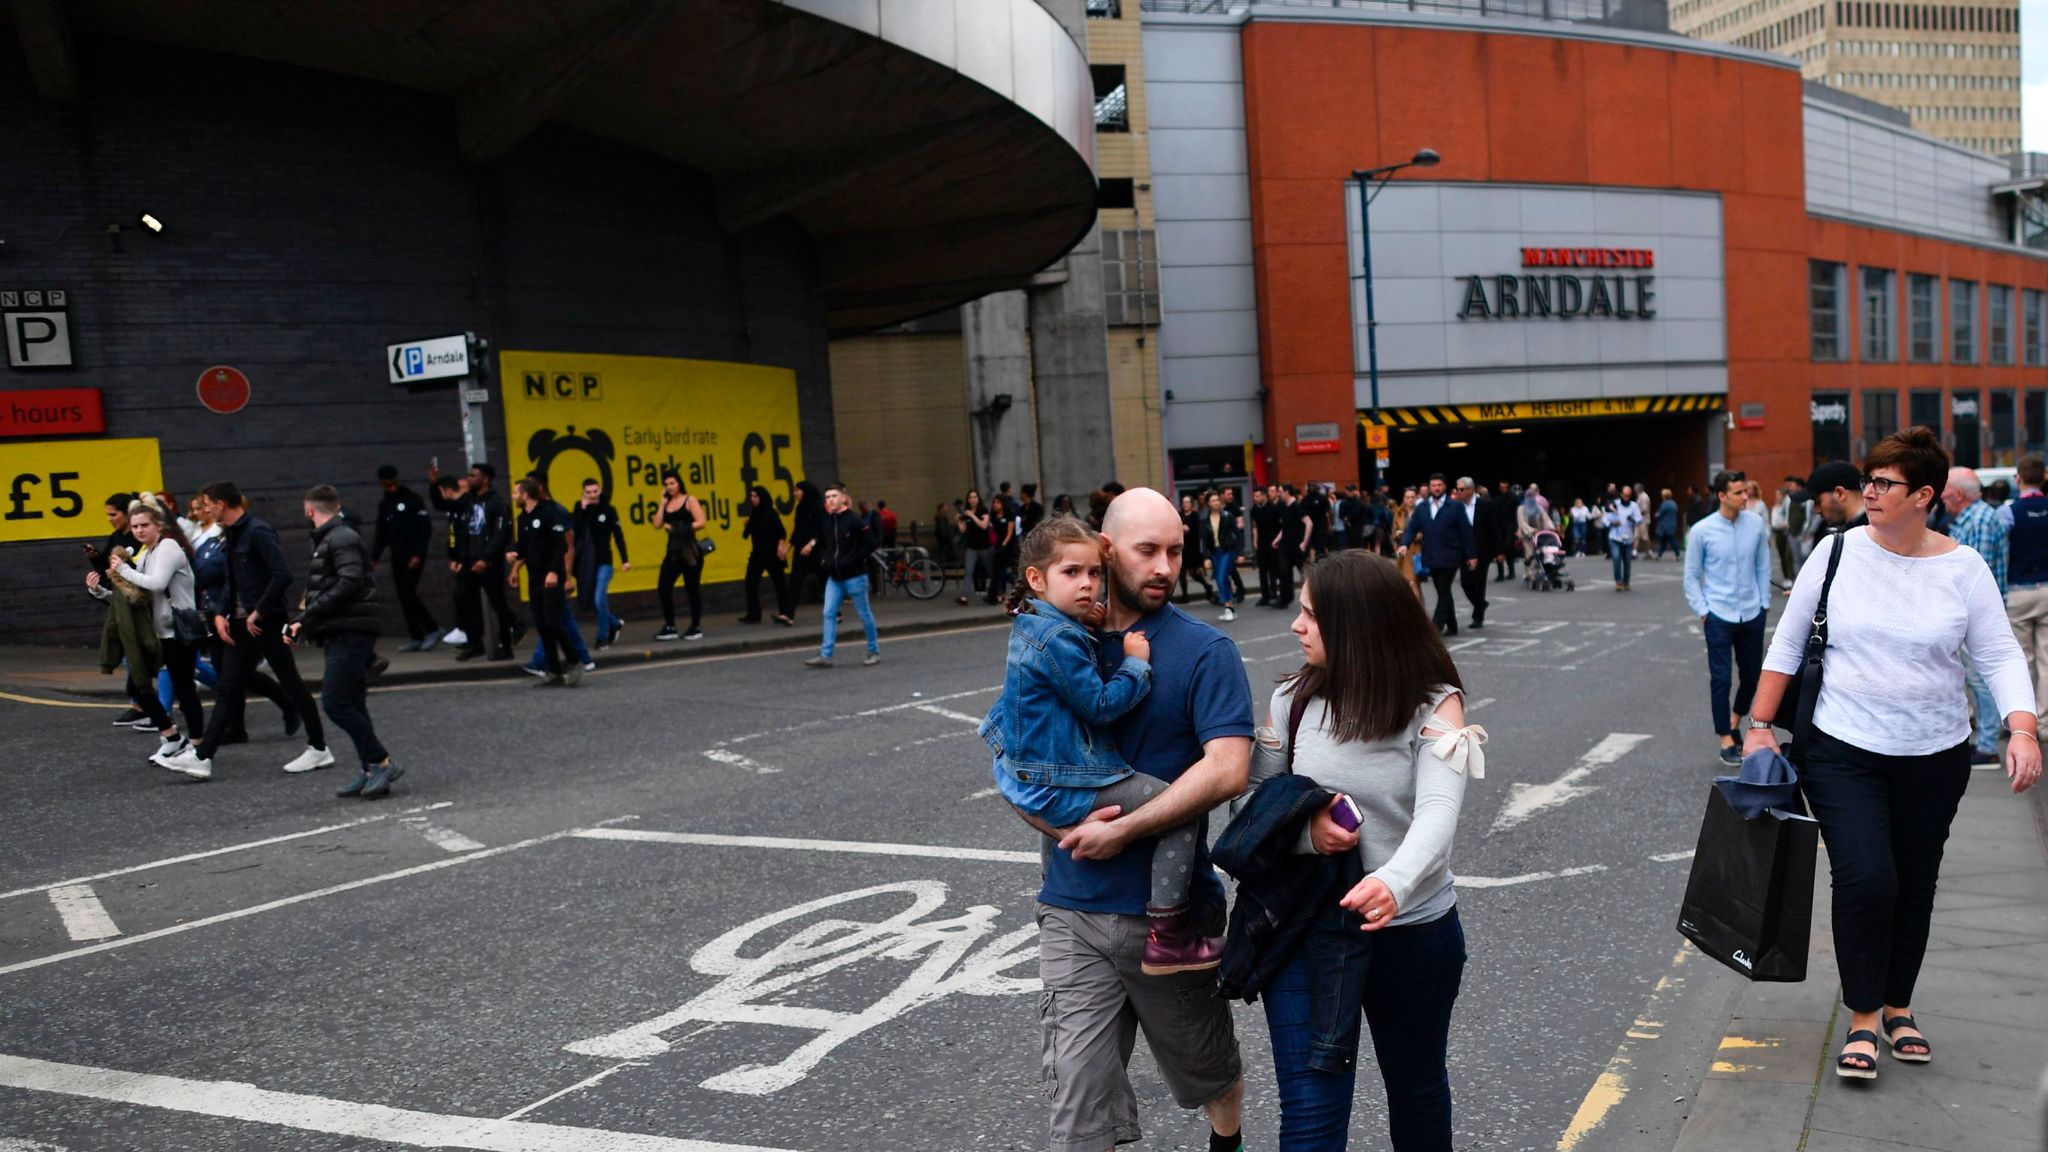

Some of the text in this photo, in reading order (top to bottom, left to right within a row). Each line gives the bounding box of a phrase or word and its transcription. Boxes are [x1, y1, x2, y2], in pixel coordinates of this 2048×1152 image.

[1520, 247, 1654, 268] MANCHESTER
[3, 291, 62, 305] NCP
[1456, 274, 1656, 320] ARNDALE
[16, 317, 57, 361] P
[427, 351, 464, 365] Arndale
[526, 375, 598, 396] NCP
[11, 404, 83, 423] hours
[1480, 403, 1517, 419] MAX
[1532, 400, 1592, 415] HEIGHT
[623, 426, 718, 451] Early bird rate
[626, 453, 715, 487] Park all
[737, 432, 795, 517] £5
[5, 472, 83, 520] £5
[629, 491, 731, 531] da nly
